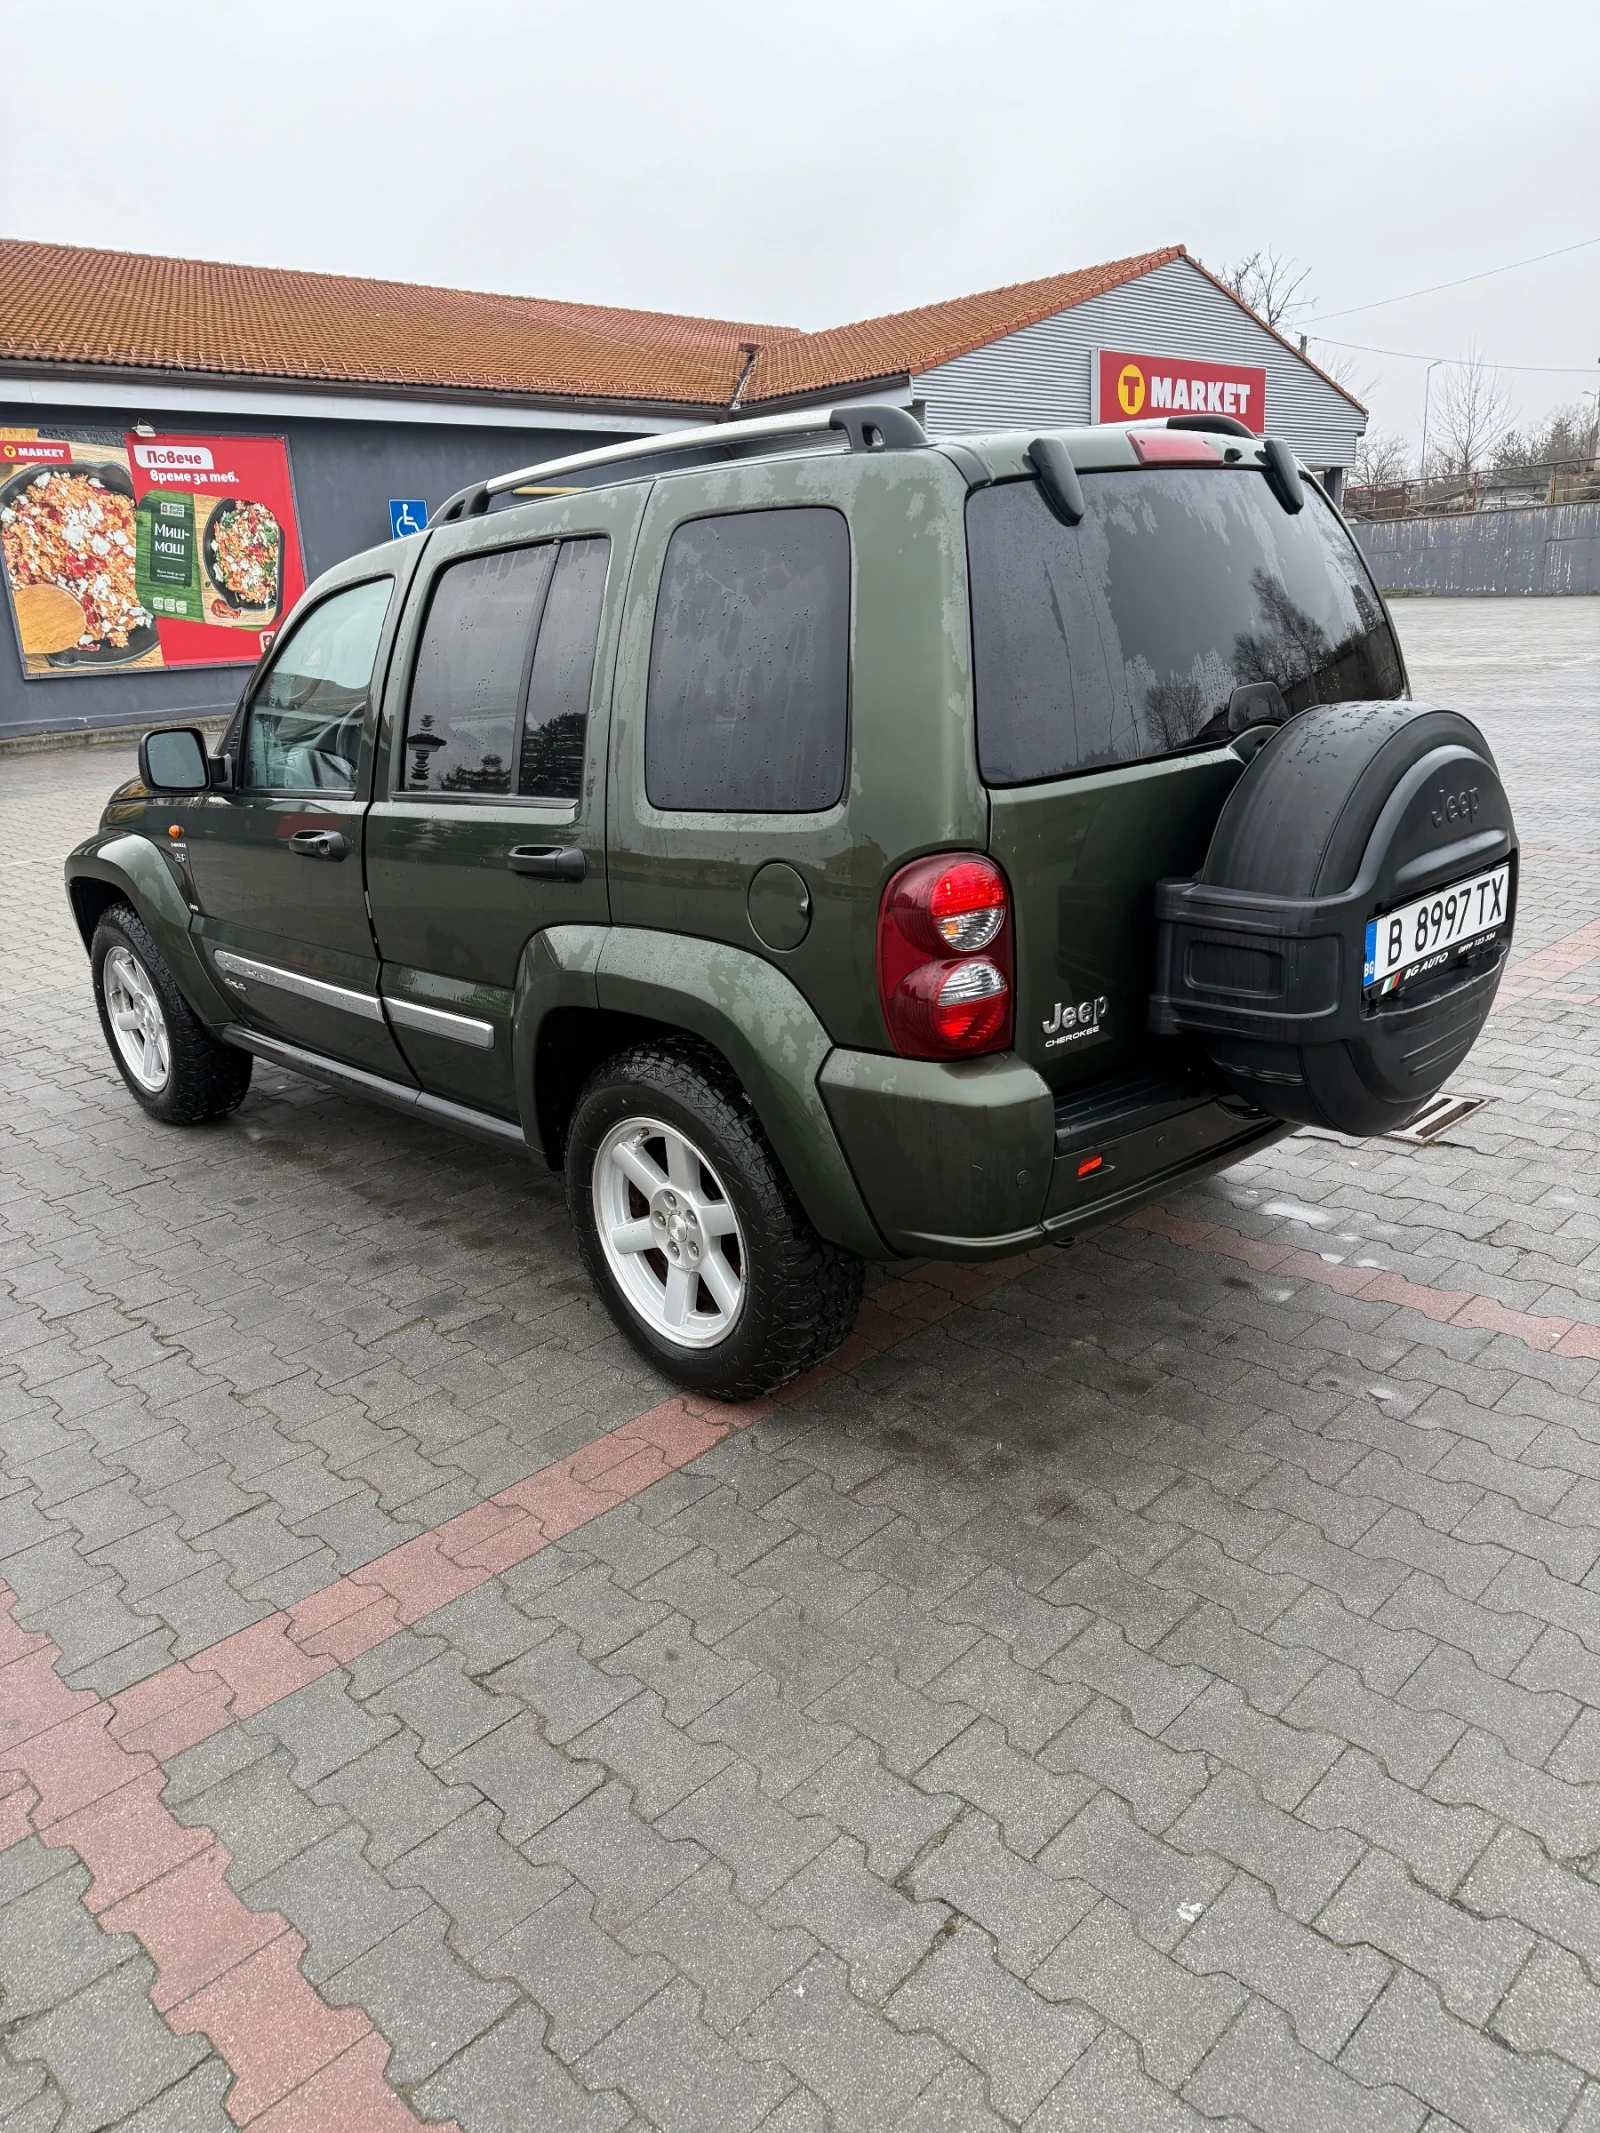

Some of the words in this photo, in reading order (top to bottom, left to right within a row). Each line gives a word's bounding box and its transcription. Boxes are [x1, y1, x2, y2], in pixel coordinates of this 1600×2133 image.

[1123, 375, 1140, 407] T
[1151, 376, 1251, 414] MARKET
[18, 446, 65, 458] MARKET
[146, 450, 202, 464] Повече
[150, 470, 192, 483] време
[194, 473, 208, 485] за
[209, 471, 240, 483] теб.
[154, 522, 190, 540] Миш-
[154, 540, 184, 555] маш
[1431, 786, 1480, 829] Jeep
[1387, 917, 1403, 968] B
[1414, 887, 1472, 953] 8997
[1476, 873, 1505, 926] TX
[1364, 960, 1375, 978] BG
[1404, 964, 1420, 981] BG
[1420, 951, 1449, 973] AUTO
[1042, 995, 1110, 1034] Jeep
[1045, 1025, 1100, 1048] CHEROKEE
